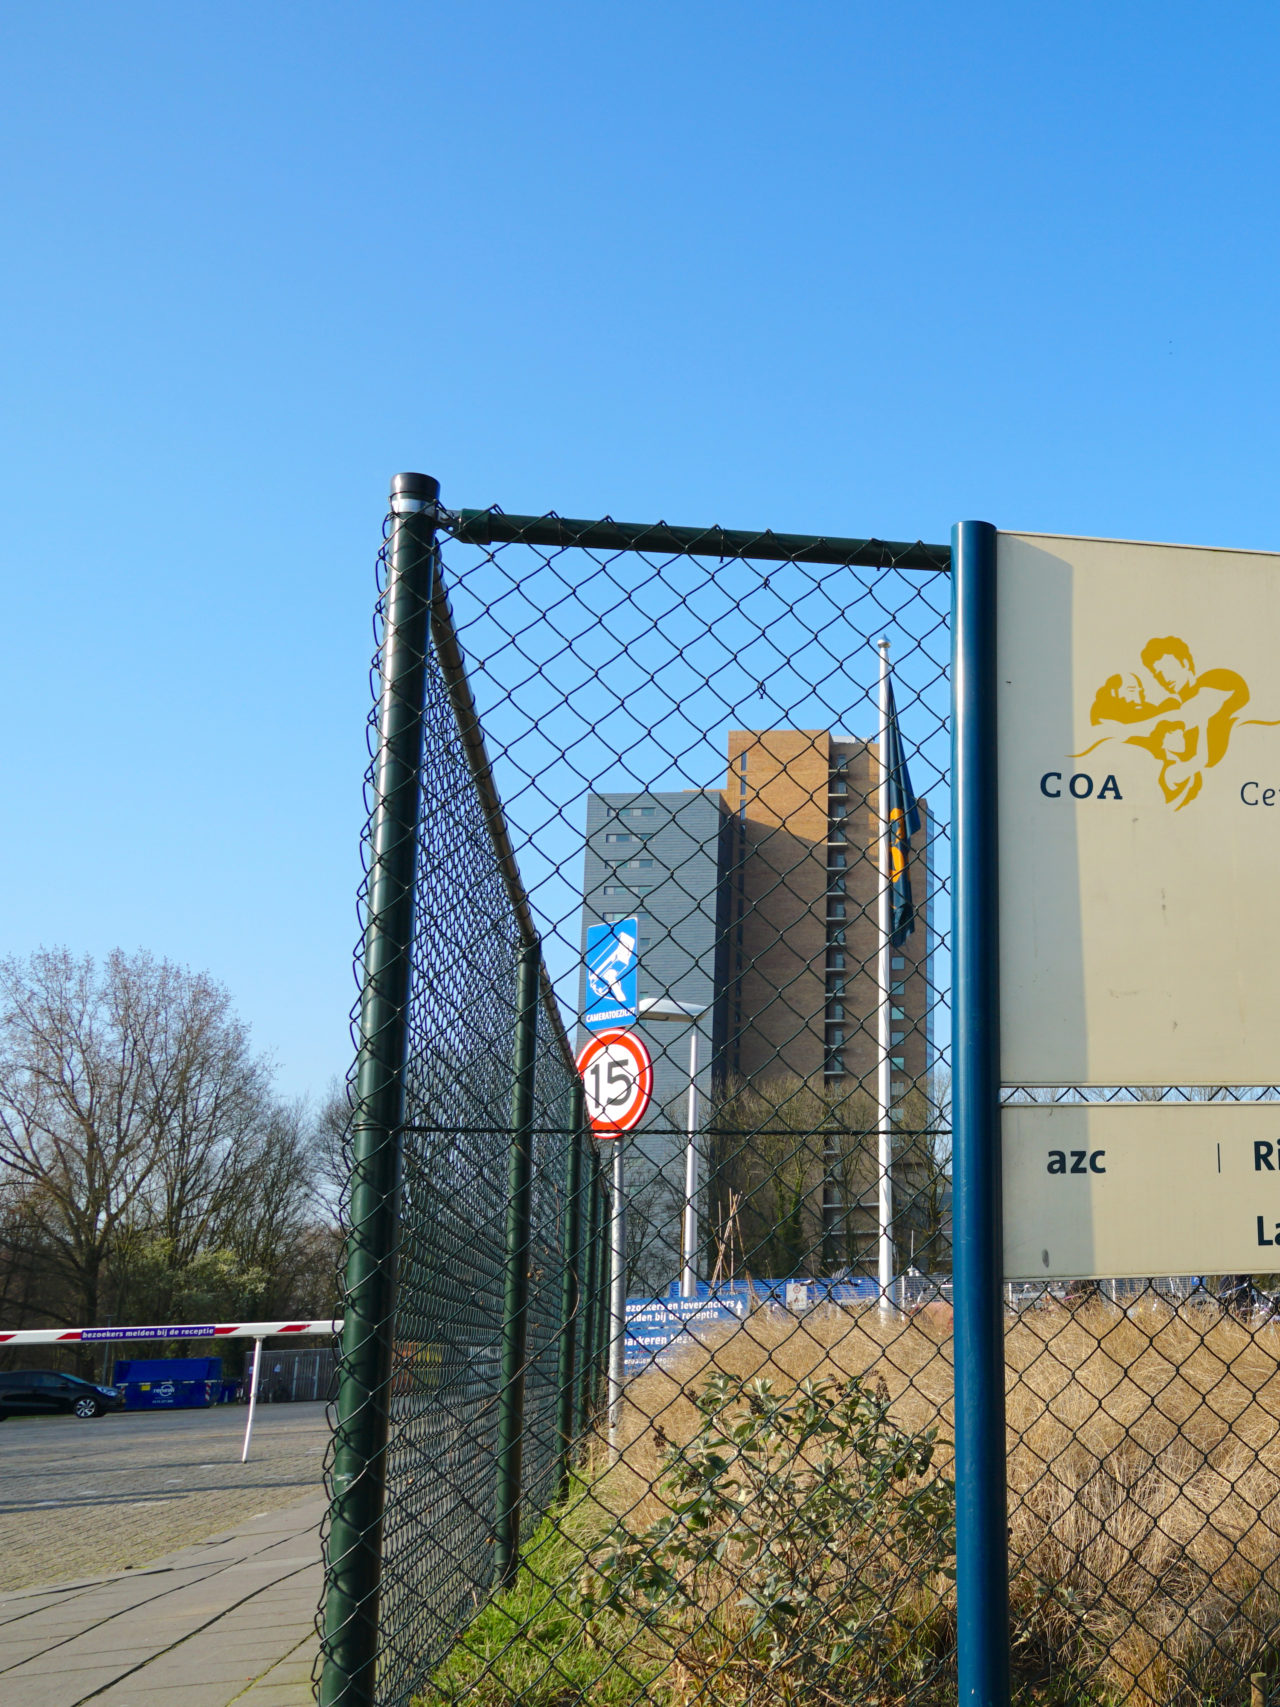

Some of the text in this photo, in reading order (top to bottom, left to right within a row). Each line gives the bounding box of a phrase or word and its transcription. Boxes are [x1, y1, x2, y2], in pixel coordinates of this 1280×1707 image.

[1040, 771, 1123, 800] COA
[590, 1059, 632, 1109] 15
[1046, 1150, 1106, 1174] azc
[625, 1304, 665, 1313] ezoekers
[655, 1311, 666, 1323] bij
[82, 1327, 214, 1339] bezoekers melden bij de receptie
[624, 1335, 667, 1346] arkeren
